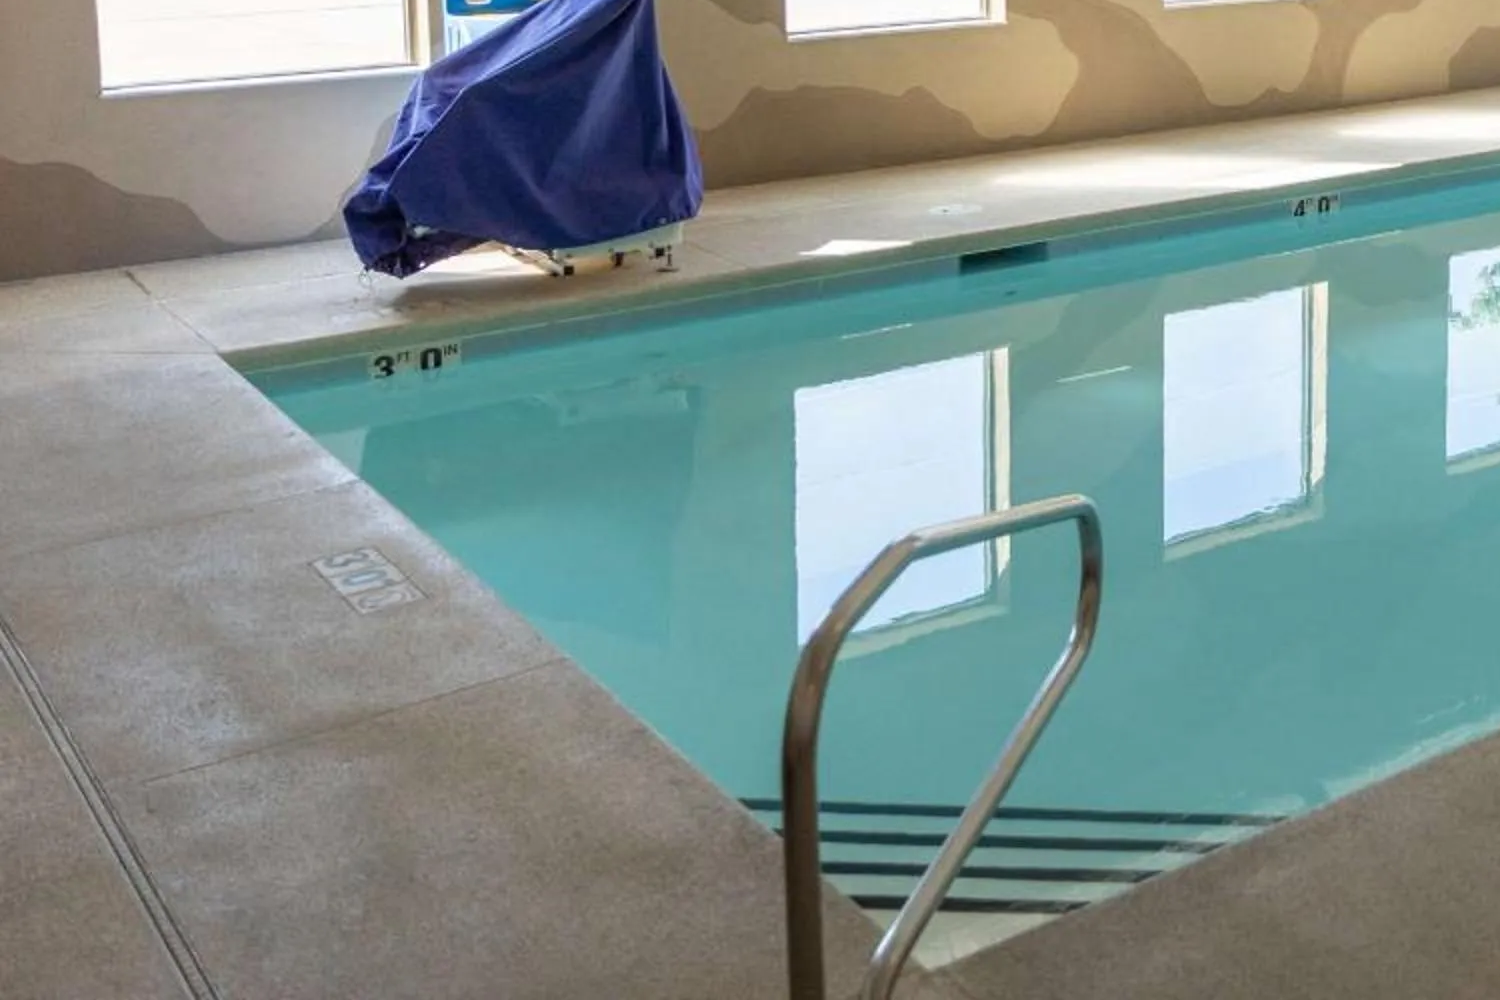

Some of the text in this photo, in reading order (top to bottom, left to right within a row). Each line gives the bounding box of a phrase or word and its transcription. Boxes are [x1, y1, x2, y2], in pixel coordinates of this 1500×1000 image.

[1294, 199, 1305, 216] 4
[374, 355, 395, 378] 3
[420, 347, 442, 370] 0
